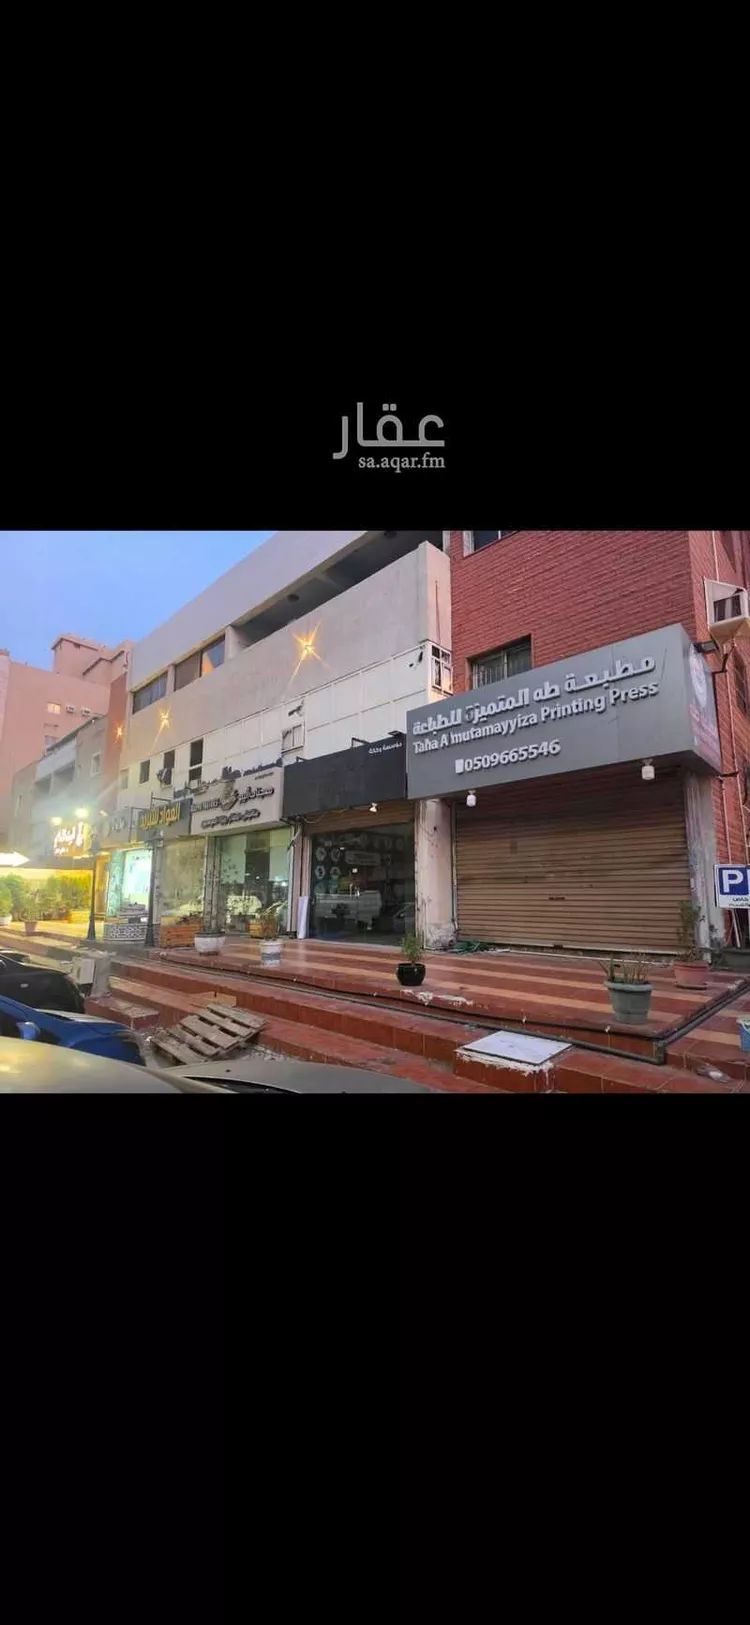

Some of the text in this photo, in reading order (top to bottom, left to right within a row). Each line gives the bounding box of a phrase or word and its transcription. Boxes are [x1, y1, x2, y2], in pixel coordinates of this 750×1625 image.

[412, 656, 656, 735] مطبعة طه المتميزة للطباعة
[412, 738, 439, 754] Taha
[540, 696, 606, 723] Printing
[610, 682, 660, 705] Press
[464, 739, 561, 772] 0509665546
[722, 869, 744, 893] P
